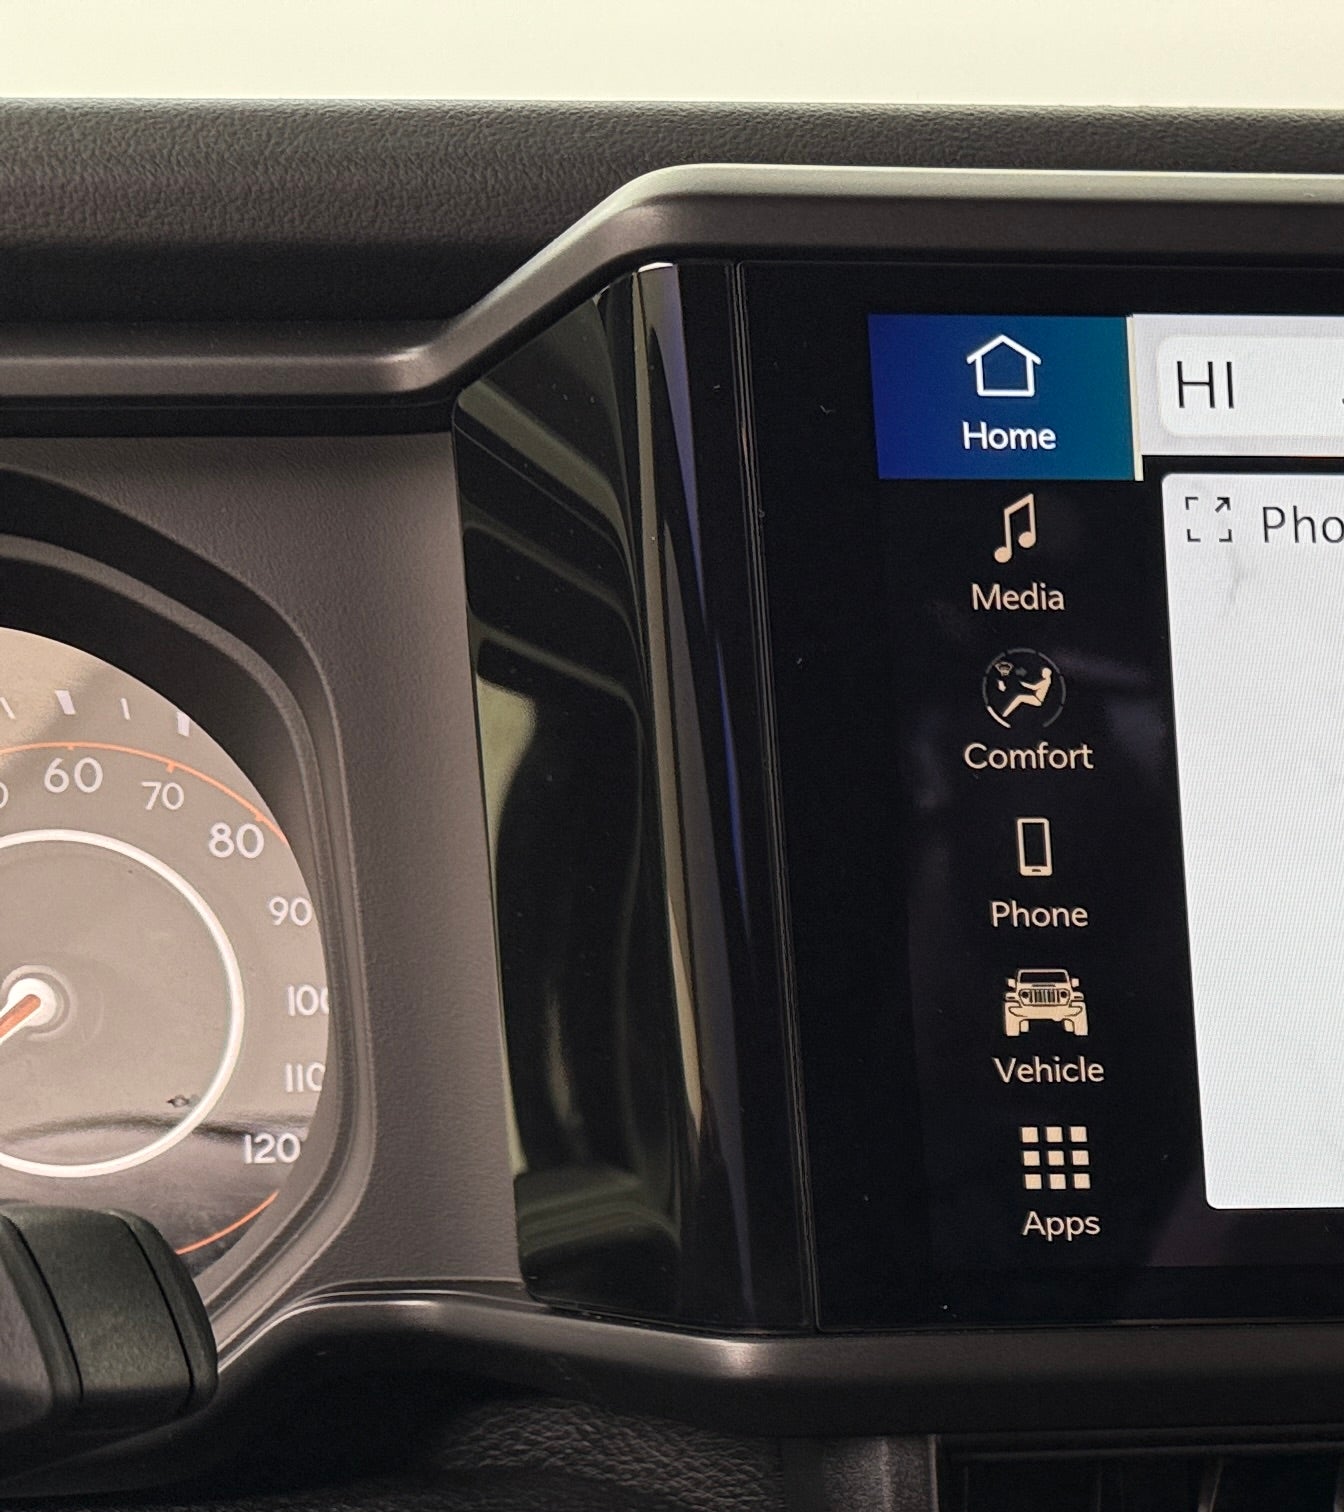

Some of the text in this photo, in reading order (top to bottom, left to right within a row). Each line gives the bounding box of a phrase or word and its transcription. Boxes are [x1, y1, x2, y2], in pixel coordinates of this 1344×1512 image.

[1176, 360, 1235, 410] HI
[962, 420, 1057, 451] Home
[971, 582, 1065, 612] Media
[963, 742, 1095, 770] Comfort
[44, 757, 103, 793] 60
[140, 780, 186, 812] 70
[208, 822, 265, 859] 80
[268, 896, 313, 926] 90
[990, 899, 1089, 928] Phone
[993, 1055, 1106, 1083] Vehicle
[244, 1132, 301, 1164] 120
[1022, 1210, 1101, 1242] Apps
